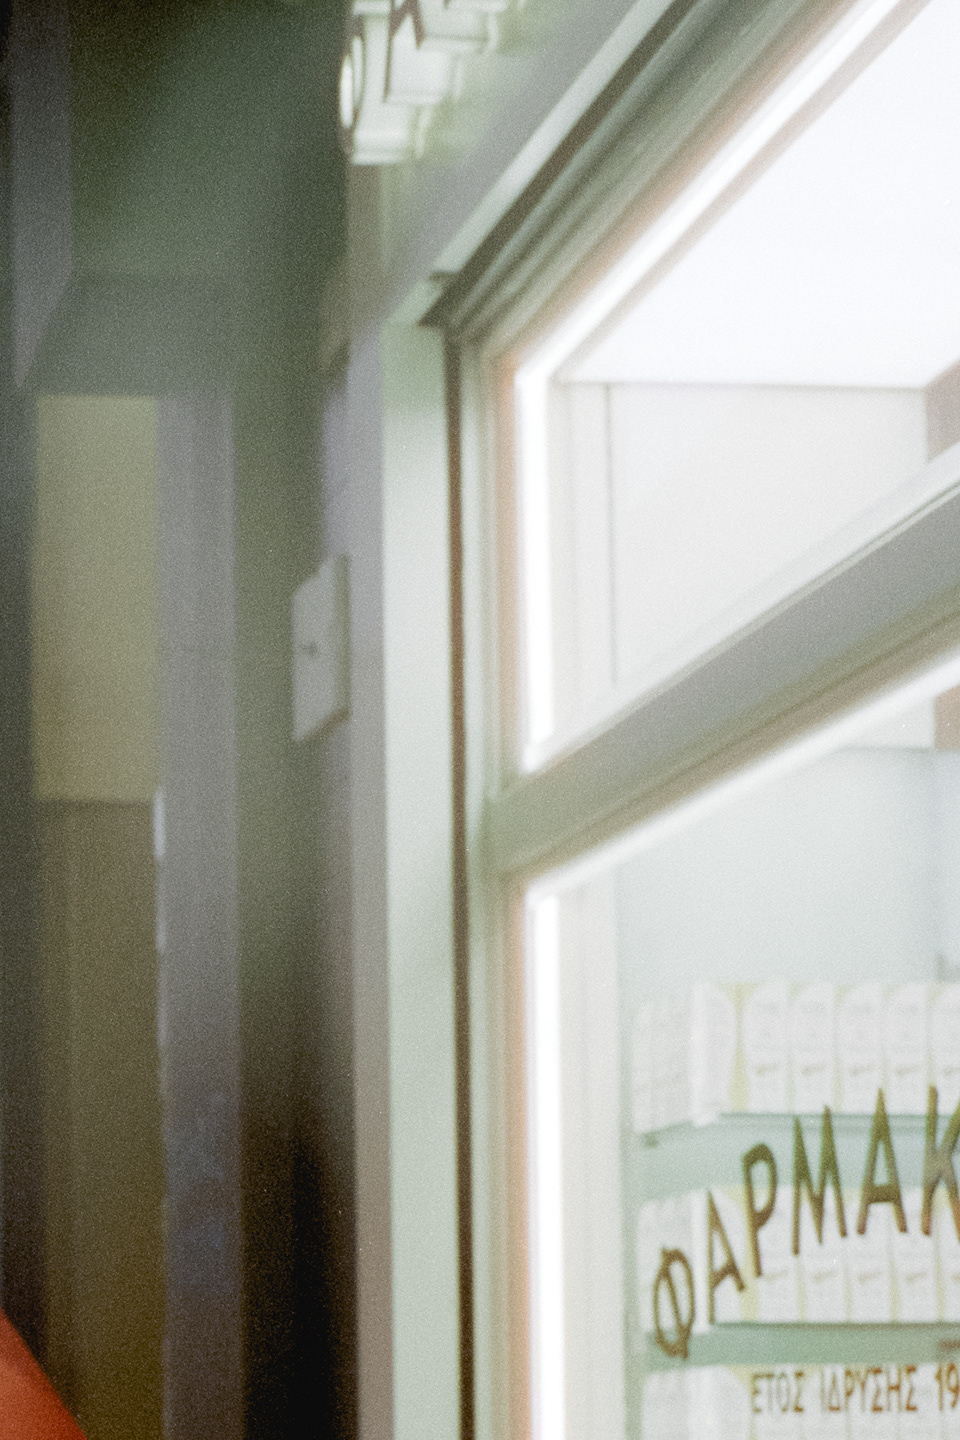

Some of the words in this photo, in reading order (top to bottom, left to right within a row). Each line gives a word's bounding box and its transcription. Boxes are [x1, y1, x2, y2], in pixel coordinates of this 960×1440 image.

[653, 1085, 960, 1360] ΦΑΡΜΑΚ
[751, 1370, 805, 1413] ΕΤΟΣ
[820, 1365, 917, 1413] ΙΔΡΥΣΗΣ
